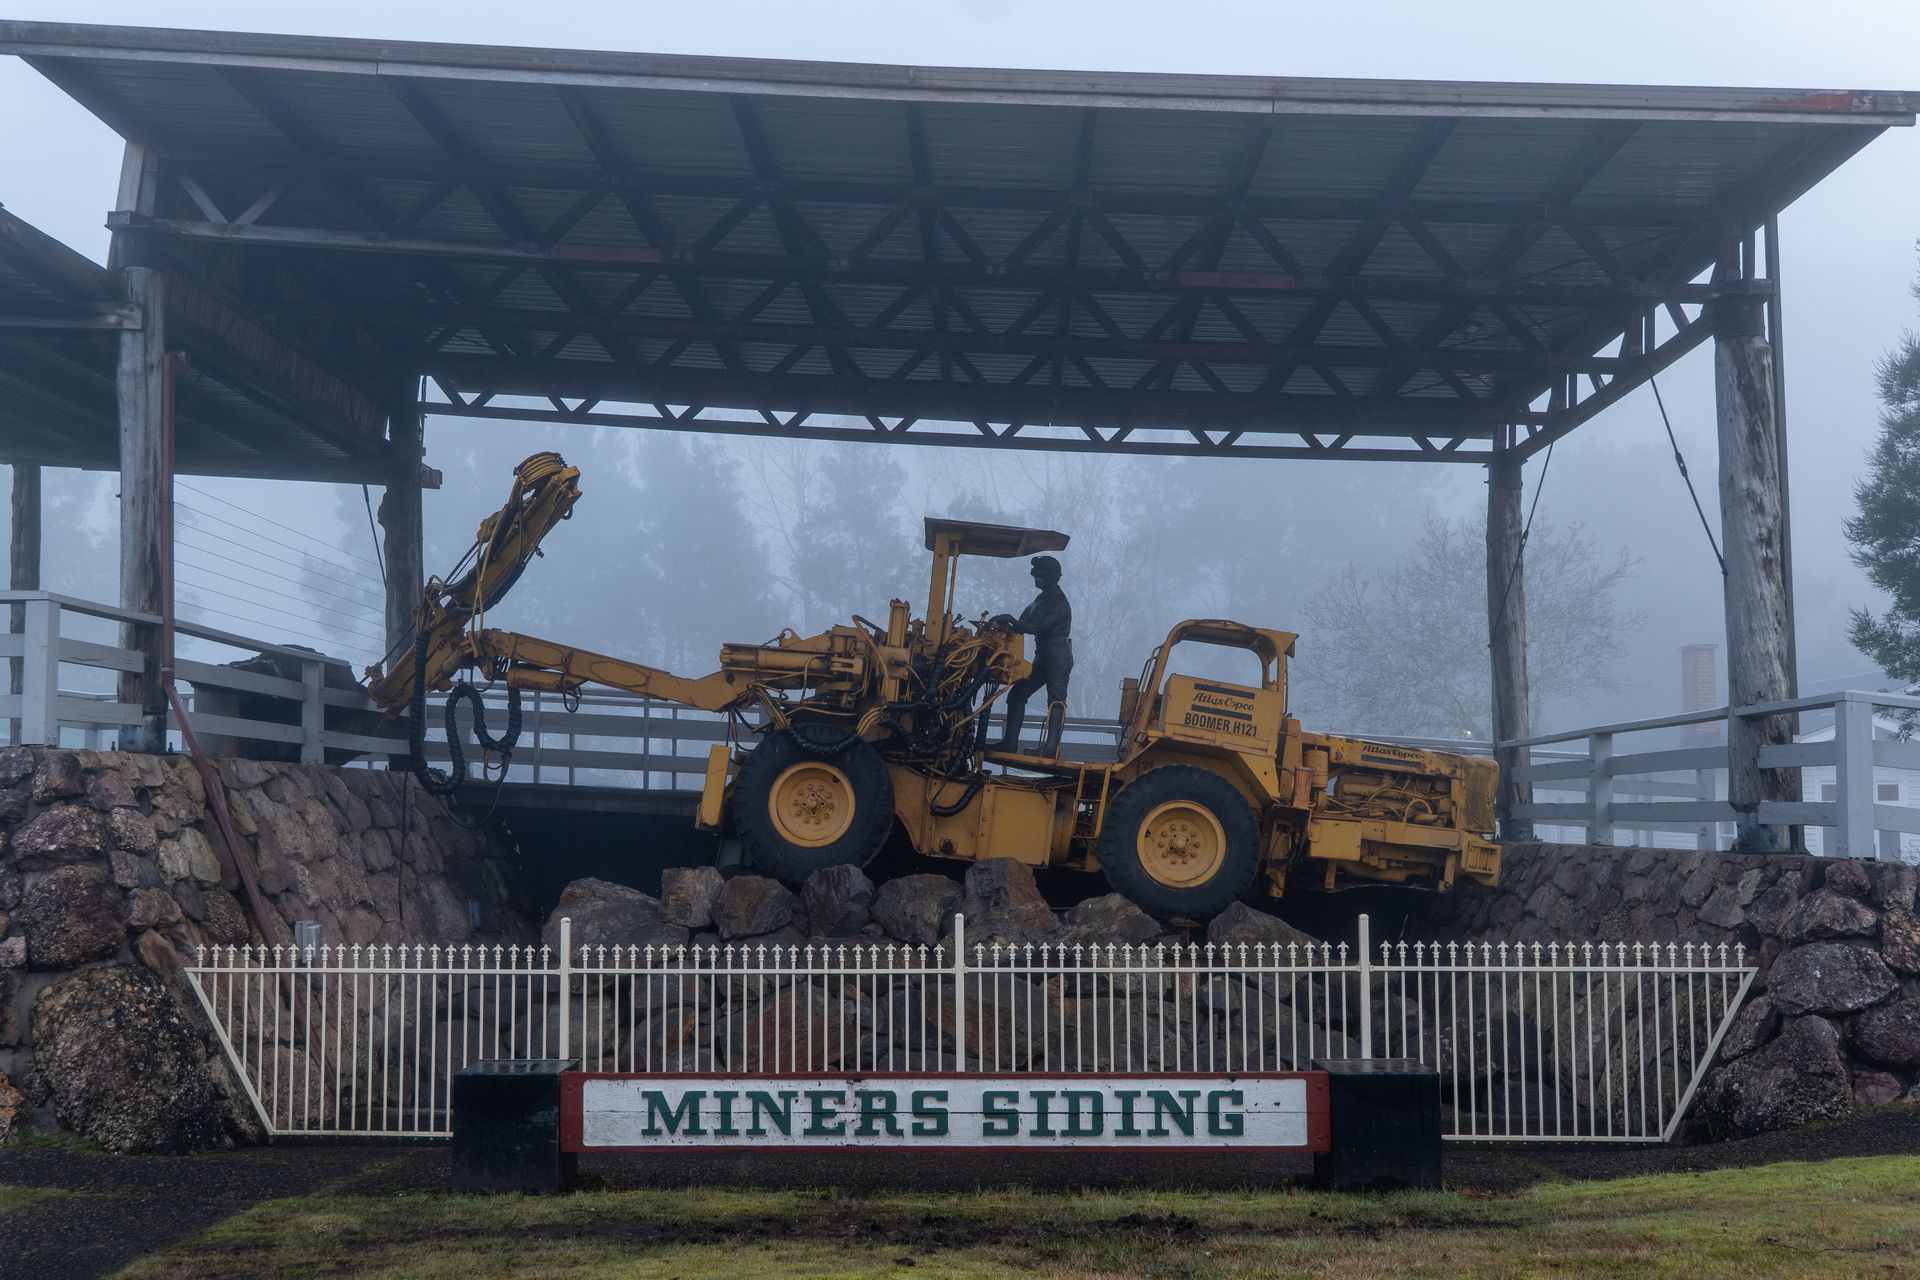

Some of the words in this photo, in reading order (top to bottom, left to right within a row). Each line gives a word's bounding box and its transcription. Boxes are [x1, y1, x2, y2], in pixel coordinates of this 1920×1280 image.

[1223, 697, 1255, 711] Copco
[1184, 712, 1231, 731] BOOMER
[1233, 721, 1258, 737] H121
[1361, 744, 1391, 755] Atlas
[1392, 749, 1422, 759] Copco
[641, 1090, 948, 1137] MINERS
[982, 1090, 1244, 1137] SIDING
